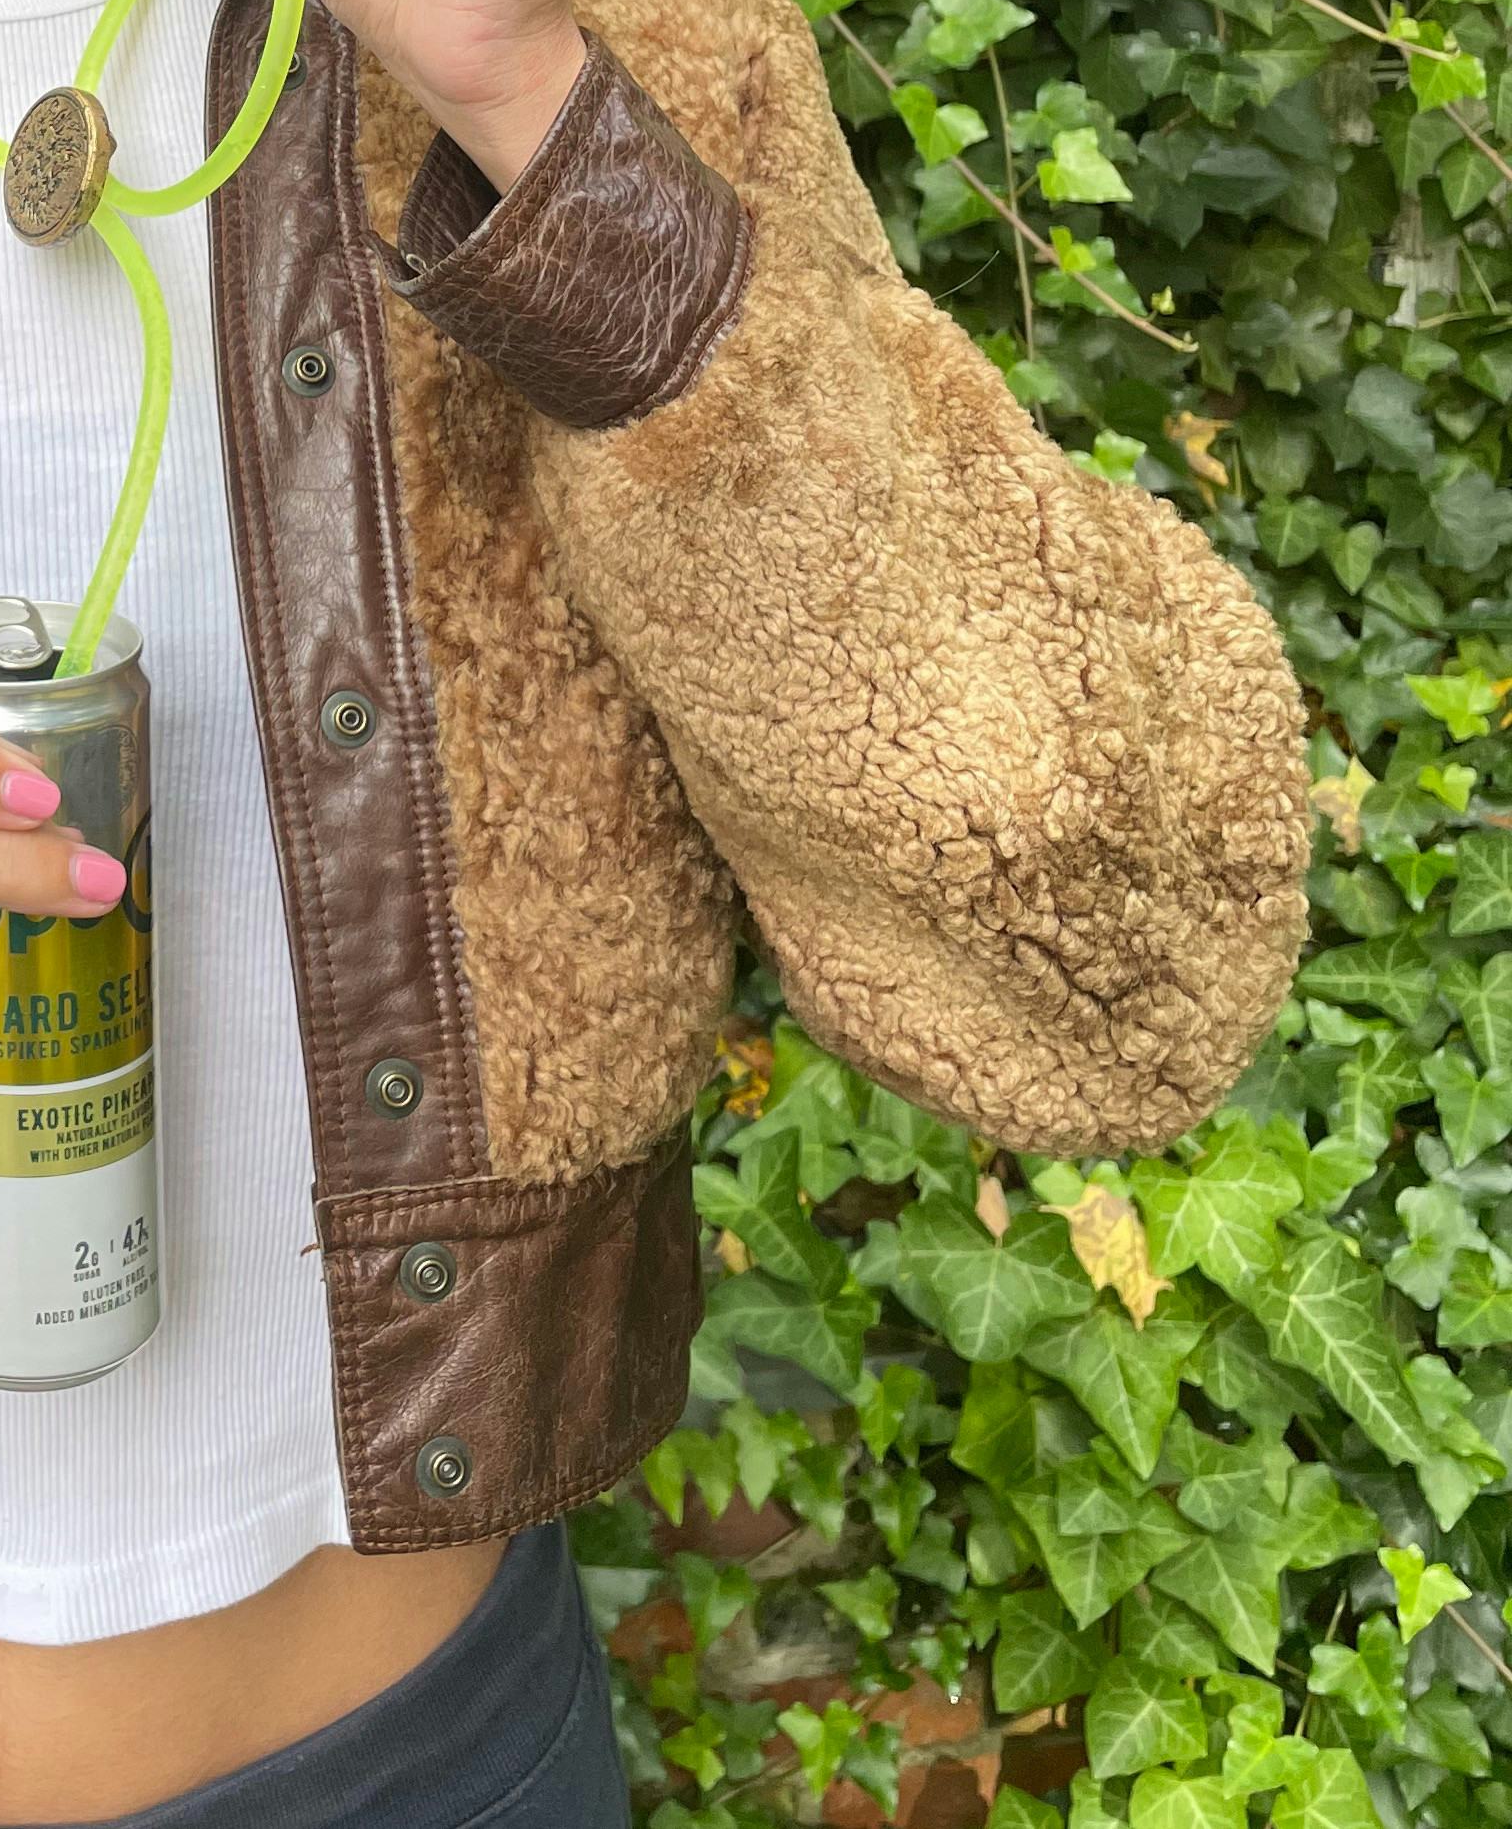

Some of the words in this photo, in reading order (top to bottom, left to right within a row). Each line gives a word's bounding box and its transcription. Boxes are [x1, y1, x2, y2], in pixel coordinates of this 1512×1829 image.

[17, 1101, 94, 1131] EXOTIC
[56, 1119, 117, 1145] NATURALLY
[30, 1148, 60, 1163] WITH
[64, 1141, 99, 1160] OTHER
[102, 1123, 141, 1151] NATURAL
[82, 1279, 123, 1303] GLUTEN
[125, 1265, 145, 1287] FREE
[35, 1310, 75, 1326] ADDED
[79, 1289, 132, 1320] MINERALS
